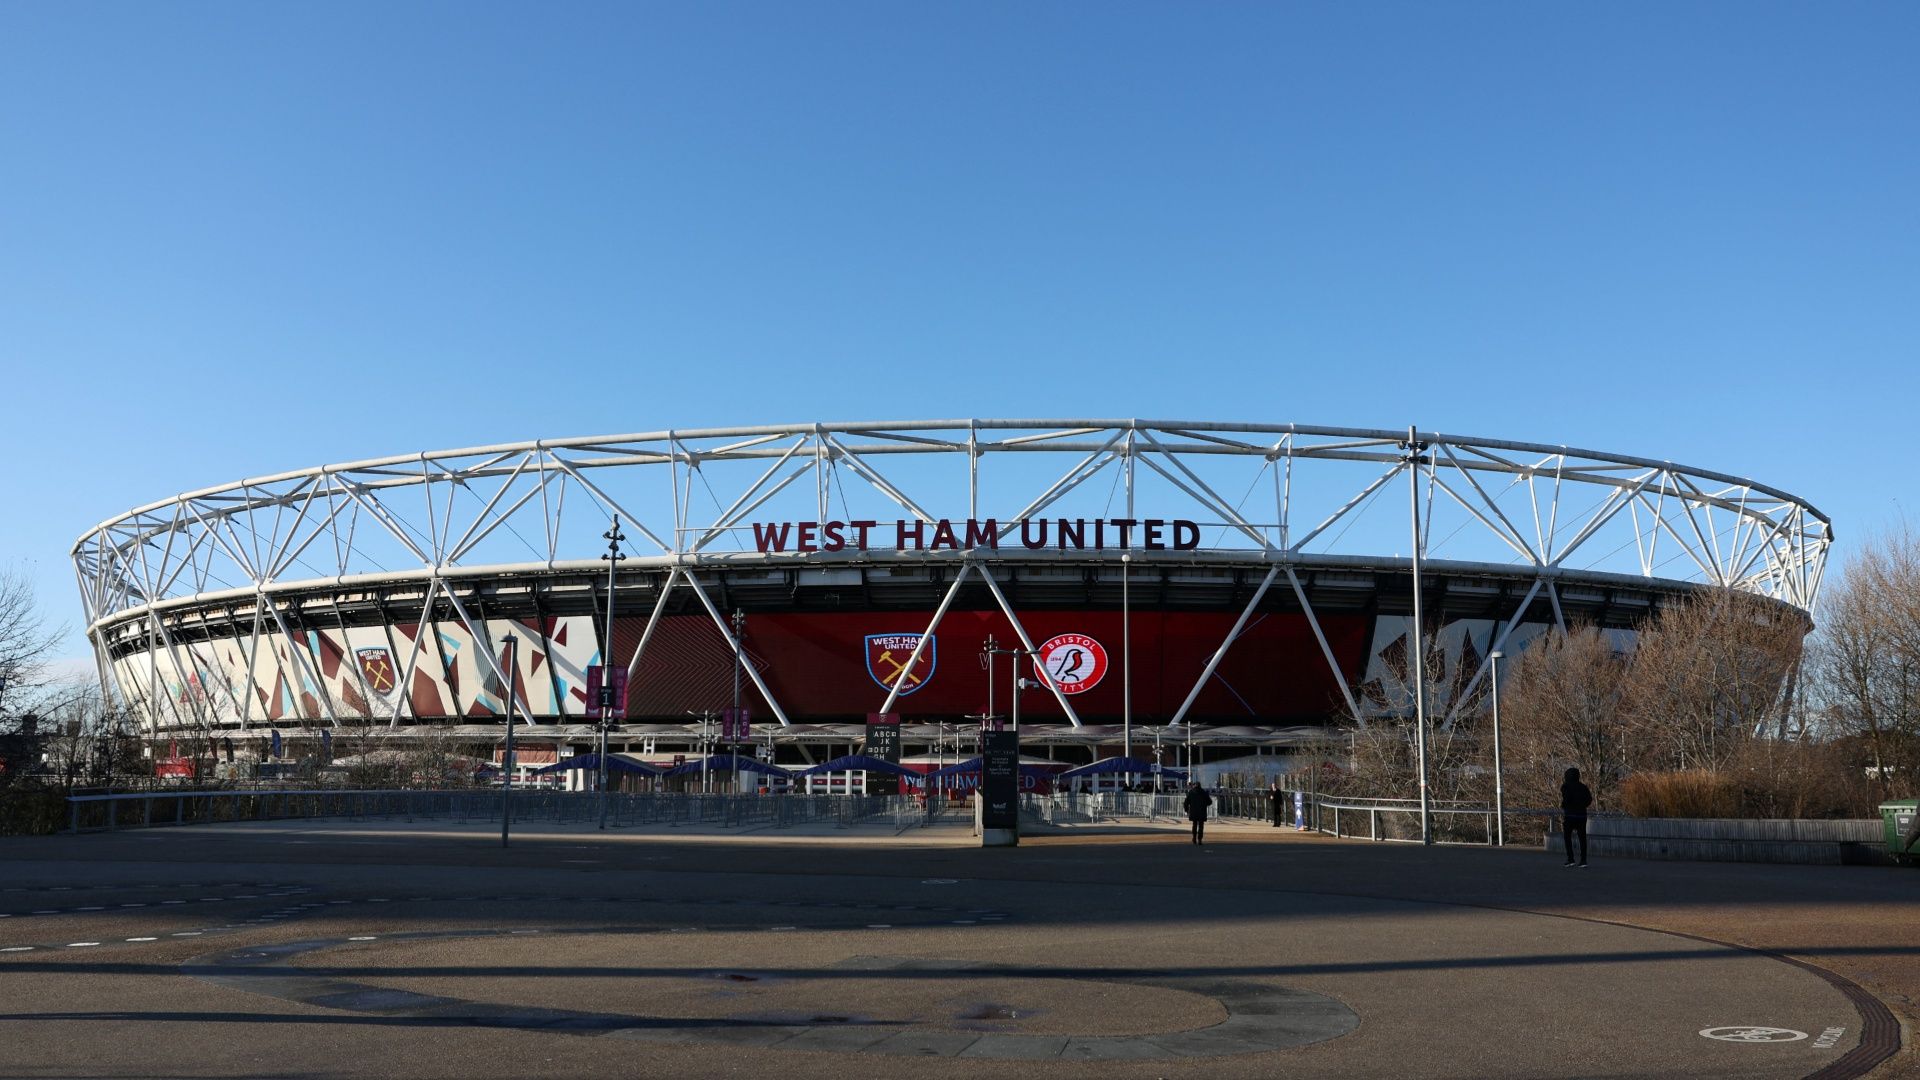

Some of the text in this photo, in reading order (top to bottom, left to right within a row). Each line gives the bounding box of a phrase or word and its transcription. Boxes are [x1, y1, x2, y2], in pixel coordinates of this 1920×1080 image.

[753, 518, 1201, 552] WEST HAM UNITED
[873, 637, 901, 646] WEST
[1047, 636, 1096, 650] BRISTOL
[890, 682, 914, 690] LDON
[1057, 682, 1086, 692] CITY
[603, 693, 610, 705] 1
[945, 775, 978, 788] HAM
